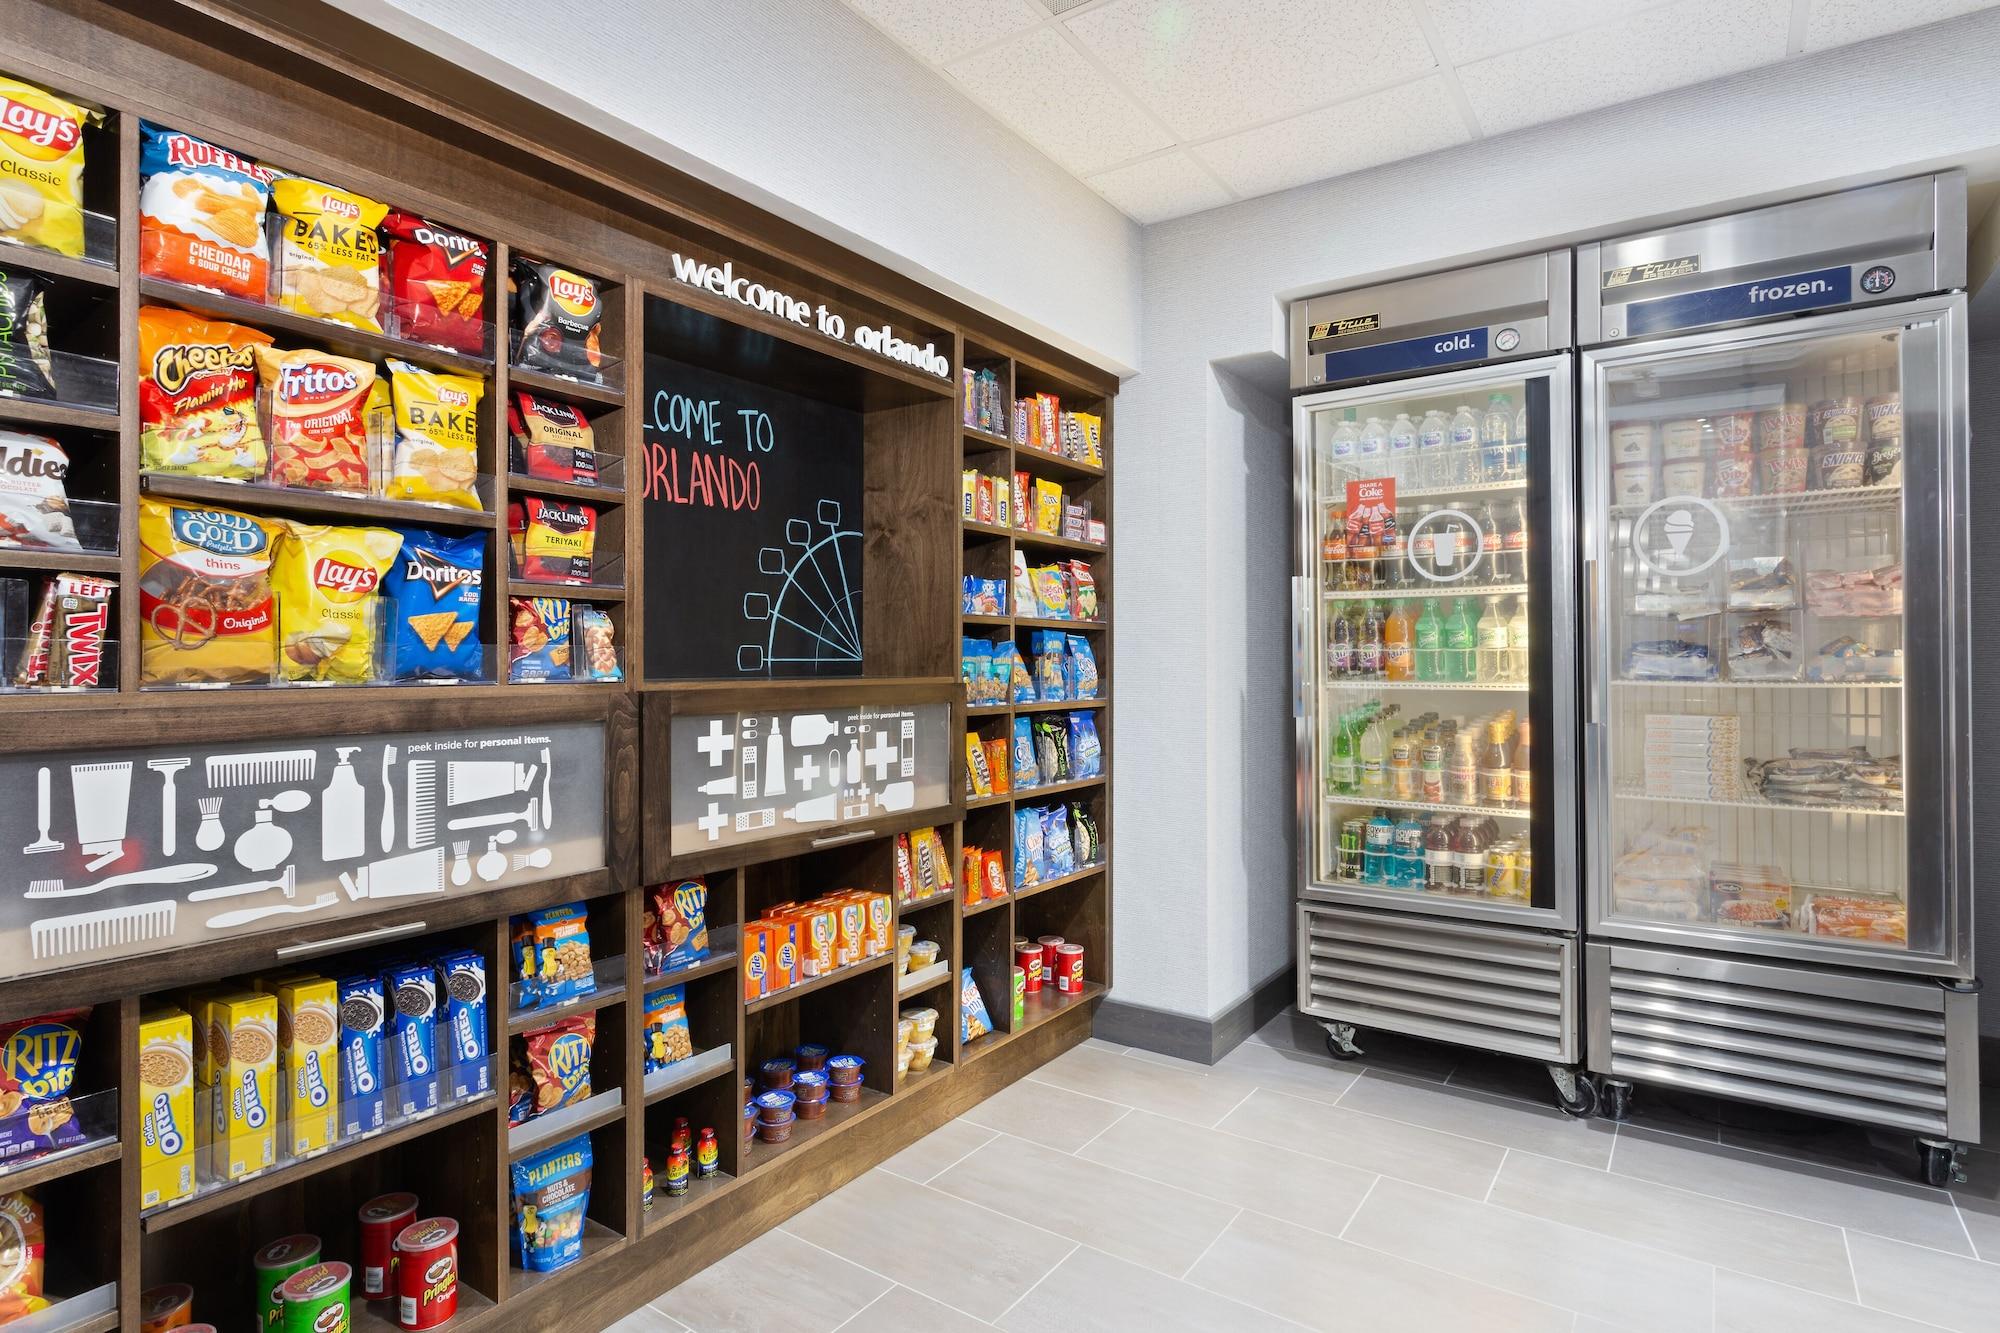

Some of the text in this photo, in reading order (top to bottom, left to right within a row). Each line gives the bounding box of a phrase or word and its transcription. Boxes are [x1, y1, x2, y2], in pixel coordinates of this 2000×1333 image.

[1, 160, 61, 186] Classic
[169, 136, 274, 186] RUFFLES
[323, 195, 360, 218] Lay's
[189, 242, 251, 273] CHEDDAR
[308, 241, 370, 263] 65% LESS FAT
[189, 257, 250, 281] & SOUR CREAM
[1749, 278, 1832, 304] frozen.
[558, 316, 589, 331] Barbecue
[671, 253, 948, 378] welcome to orlando
[1434, 334, 1475, 354] cold.
[156, 344, 255, 392] Cheetos
[280, 363, 358, 400] Fritos
[304, 408, 354, 429] ORIGINAL
[532, 402, 557, 415] JACK
[447, 431, 464, 441] LESS
[543, 425, 583, 439] ORIGINAL
[737, 409, 774, 452] TO
[1359, 488, 1384, 498] Coke
[536, 508, 562, 523] JACK
[182, 520, 259, 551] GOLD
[545, 535, 582, 547] TERIYAKI
[205, 558, 241, 571] thins
[317, 559, 376, 593] Lay's
[407, 561, 482, 585] Doritos
[70, 582, 110, 597] LEFT
[223, 611, 268, 631] Original
[322, 608, 361, 620] Classic
[880, 711, 900, 720] personal
[407, 735, 552, 754] peek inside for personal items.
[1015, 816, 1026, 874] TRADITIONAL
[751, 955, 761, 978] Tide
[782, 946, 791, 967] Tide
[459, 1008, 482, 1060] OREO
[7, 1030, 79, 1081] RITZ
[406, 1022, 429, 1076] OREO
[352, 1037, 376, 1095] OREO
[22, 1066, 76, 1097] bits
[305, 1050, 328, 1107] OREO
[242, 1069, 266, 1128] OREO
[145, 1113, 155, 1146] Golden
[153, 1092, 183, 1156] OREO
[529, 1152, 582, 1187] PLANTERS
[542, 1183, 576, 1204] CHOCOLATE
[546, 1179, 569, 1194] NUTS &
[423, 1271, 457, 1307] Pringles
